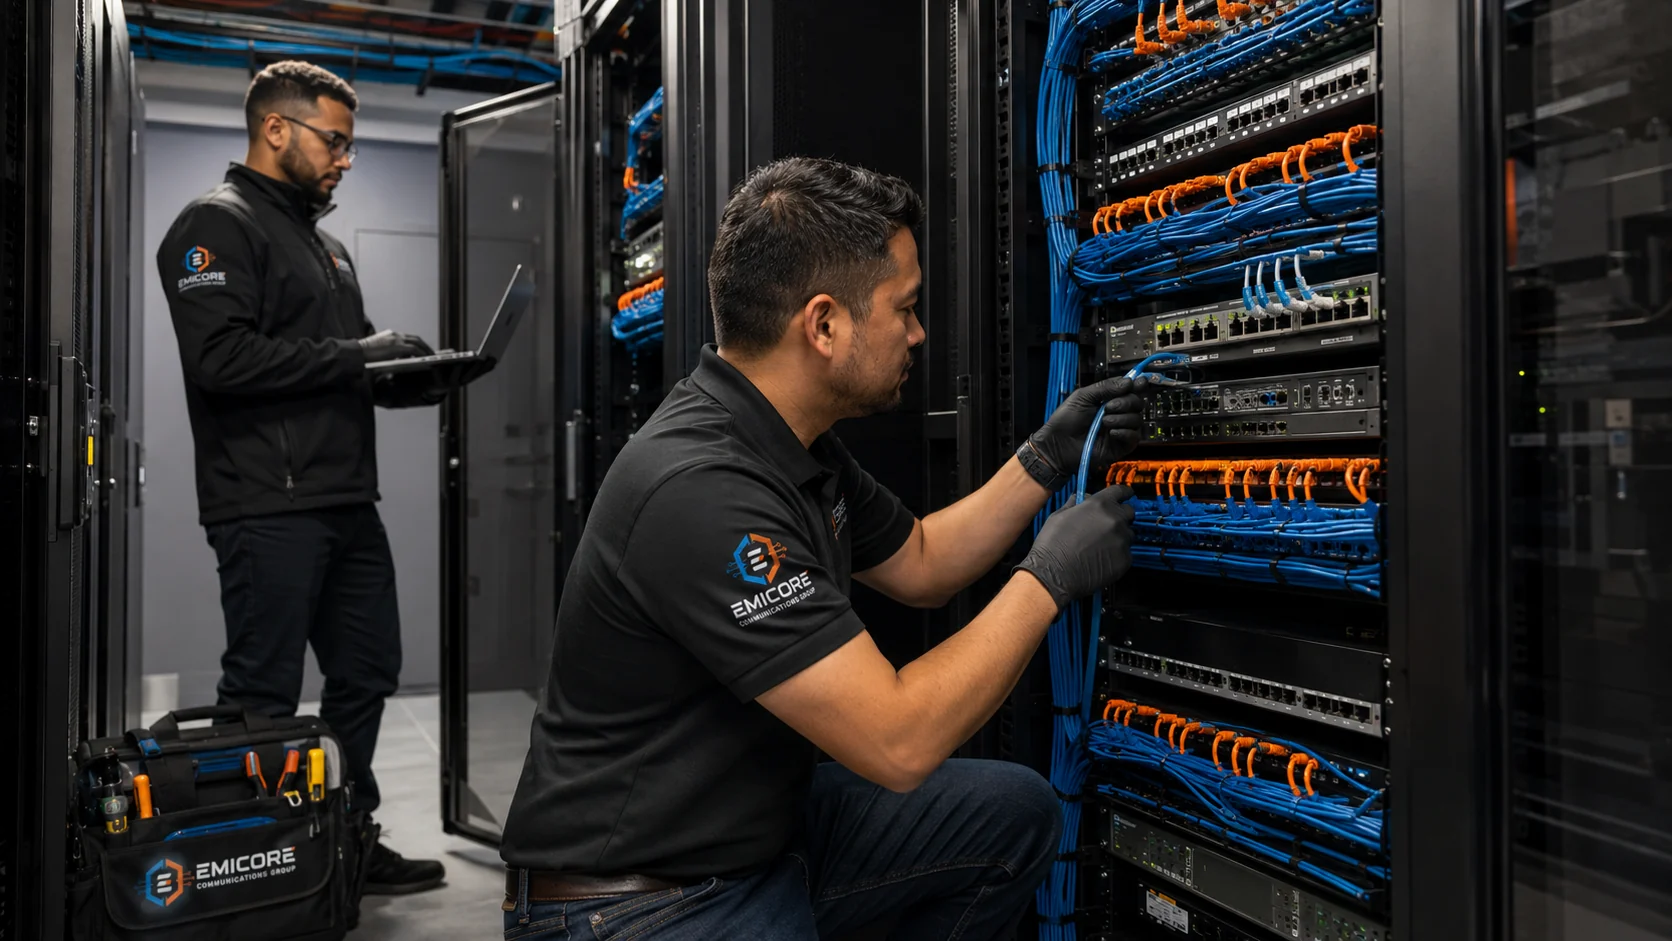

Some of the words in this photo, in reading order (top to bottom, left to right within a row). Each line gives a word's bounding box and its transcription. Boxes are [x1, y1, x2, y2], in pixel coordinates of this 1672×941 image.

[178, 272, 226, 289] EMICORE
[730, 569, 812, 619] EMICORE
[196, 846, 296, 880] EMICORE
[196, 871, 268, 889] COMMUNICATIONS
[270, 865, 296, 876] GROUP
